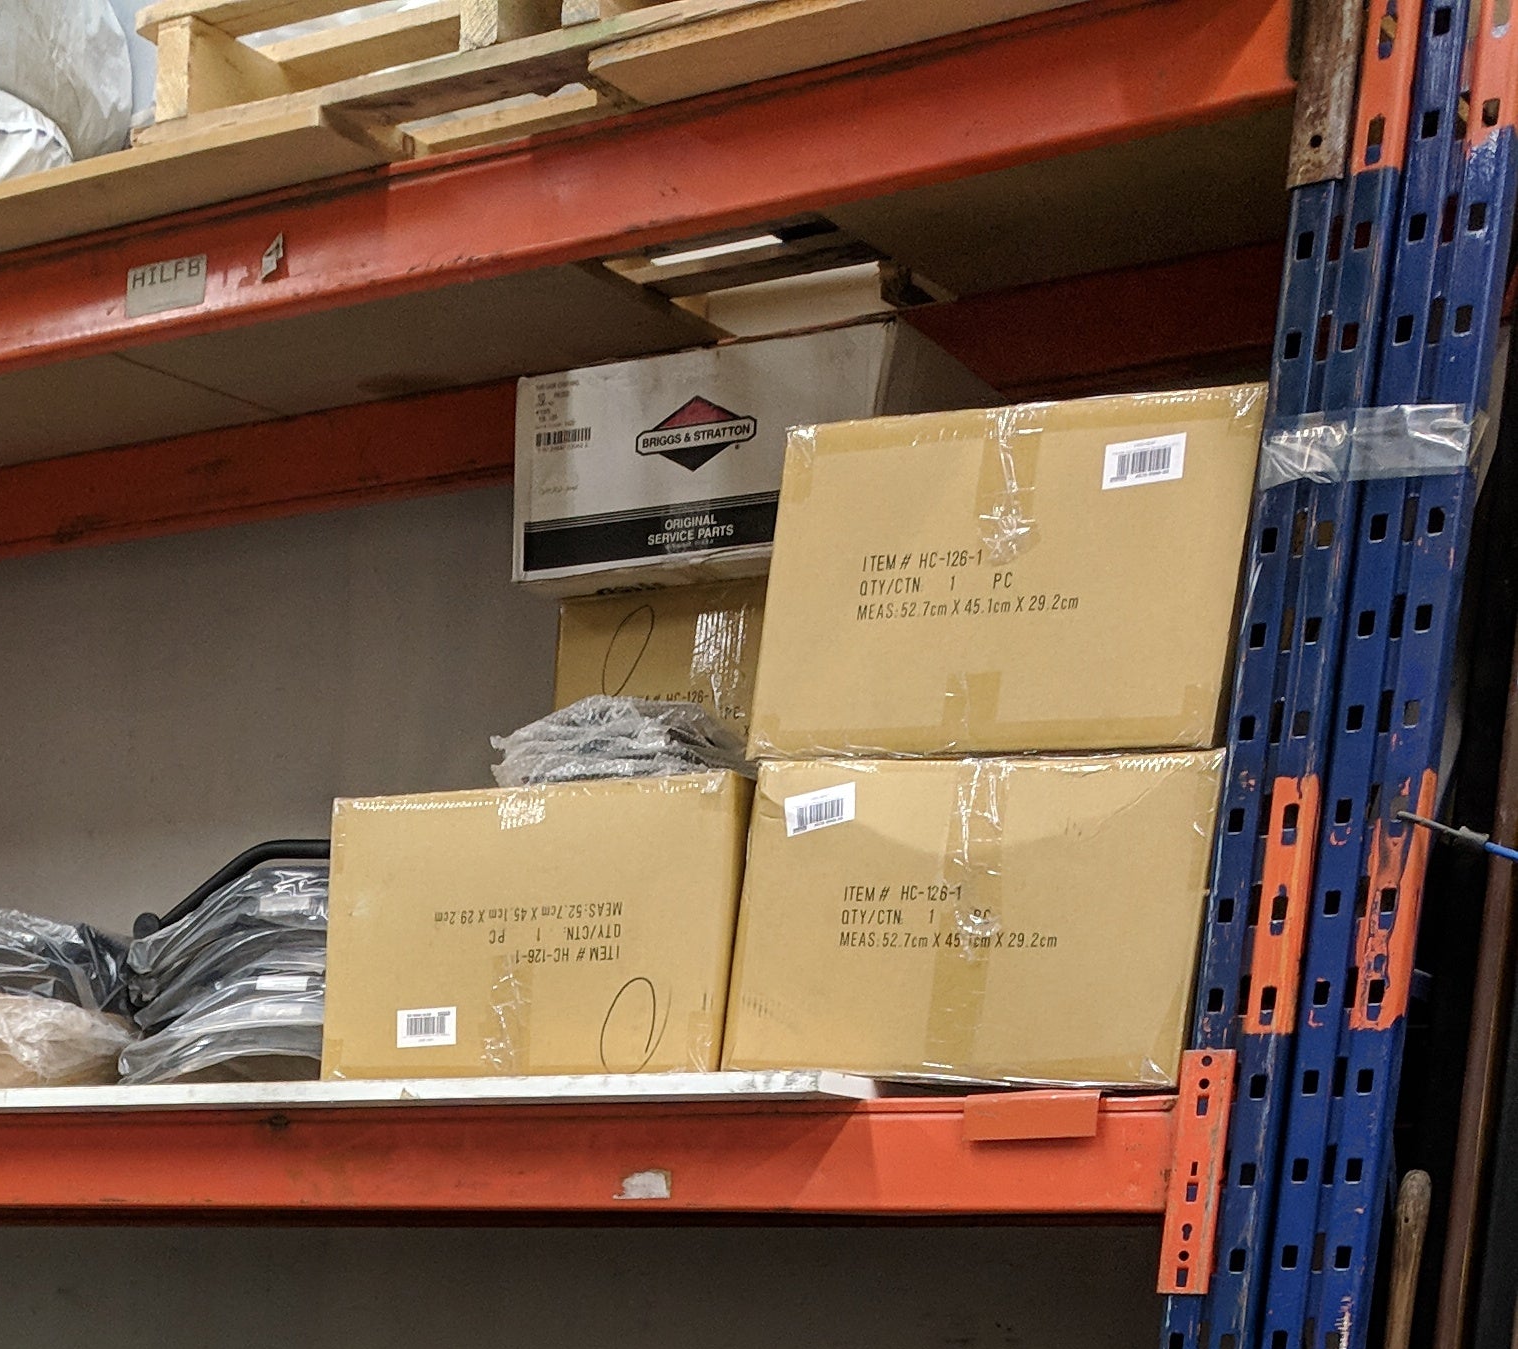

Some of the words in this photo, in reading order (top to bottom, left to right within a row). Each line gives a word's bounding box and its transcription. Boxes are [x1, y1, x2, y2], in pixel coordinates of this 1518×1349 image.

[642, 433, 682, 448] BRIGGS
[684, 433, 691, 442] &
[693, 424, 750, 441] STRATTON
[664, 514, 718, 530] ORIGINAL
[647, 530, 695, 546] SERVICE
[697, 524, 734, 539] PARTS
[862, 554, 896, 572] ITEM
[919, 549, 983, 569] HC-126-1
[949, 575, 956, 591] 1
[993, 571, 1013, 589] PC
[951, 599, 960, 616] X
[964, 598, 1011, 616] 45.1cm
[1014, 596, 1023, 613] X
[1028, 594, 1079, 612] 29.2cm
[844, 886, 875, 902] ITEM
[901, 885, 962, 902] HC-126-1
[434, 910, 474, 925] 29.2cm
[477, 909, 485, 924] X
[488, 907, 527, 922] 45.1cm
[531, 906, 538, 920] X
[929, 908, 935, 924] 1
[489, 928, 506, 944] PC
[536, 927, 541, 942] 1
[932, 932, 940, 947] X
[994, 932, 1003, 948] X
[1008, 932, 1058, 948] 29.2cm
[515, 947, 569, 964] HC-126-1
[589, 945, 620, 961] ITEM
